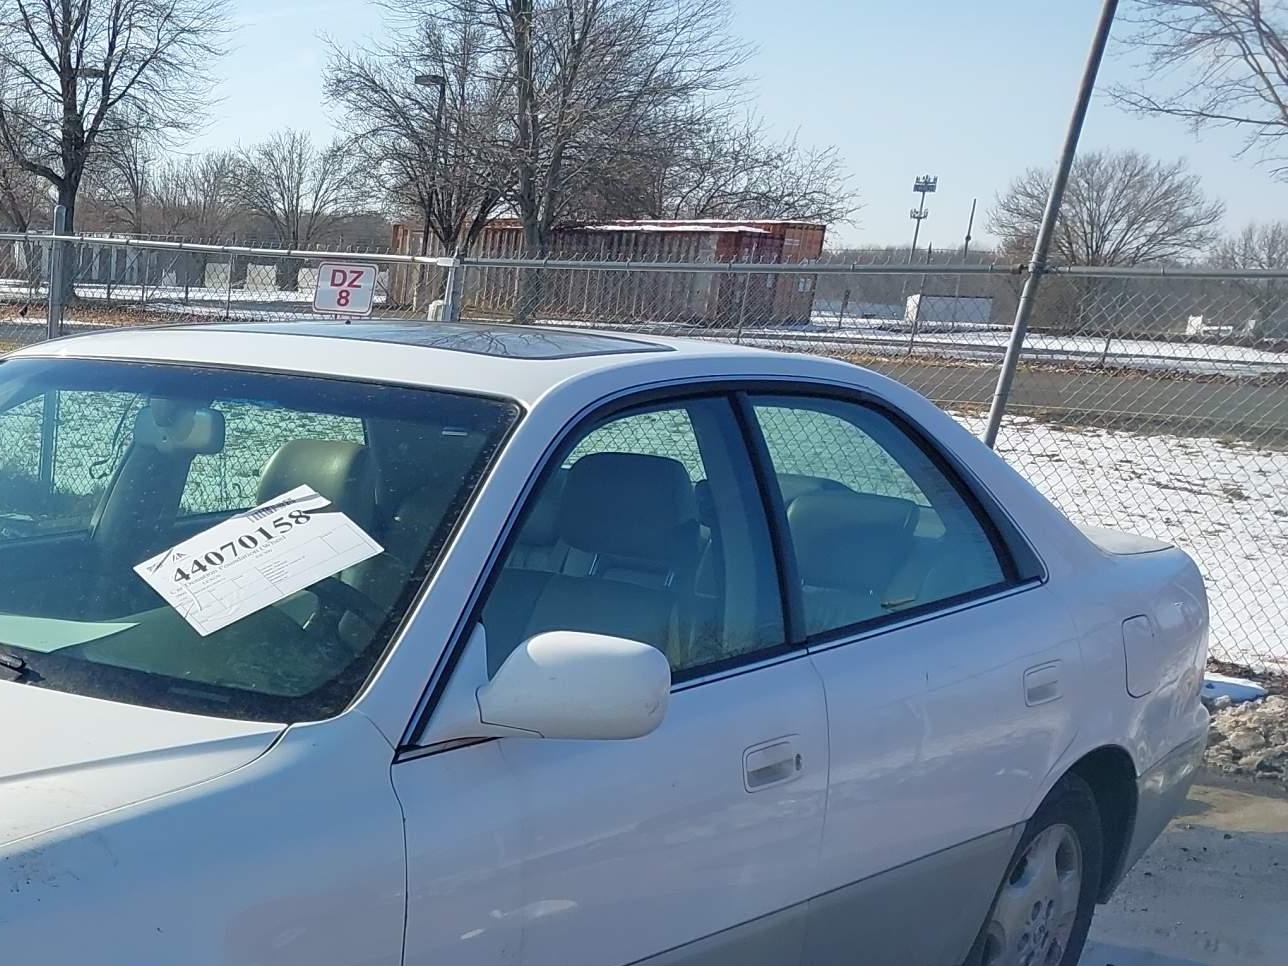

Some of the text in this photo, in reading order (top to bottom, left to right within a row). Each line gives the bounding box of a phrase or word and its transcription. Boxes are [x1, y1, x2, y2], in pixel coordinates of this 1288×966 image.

[330, 269, 364, 288] DZ
[336, 289, 351, 307] 8
[173, 509, 312, 583] 44070158
